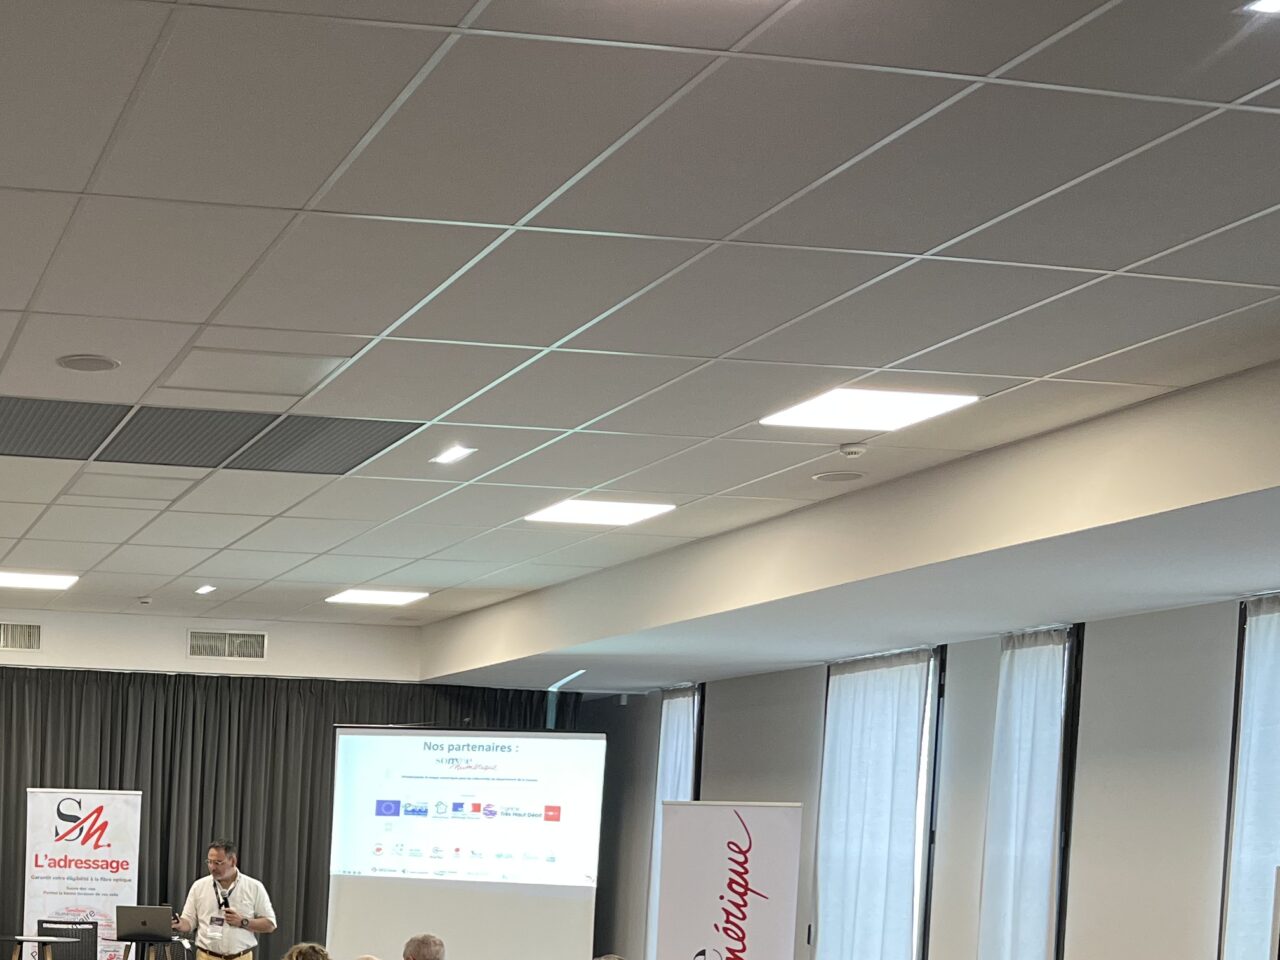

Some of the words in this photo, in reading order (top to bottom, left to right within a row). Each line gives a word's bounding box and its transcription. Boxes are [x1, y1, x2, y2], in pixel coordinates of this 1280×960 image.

[423, 741, 444, 751] Nos
[447, 742, 512, 753] partenaires
[34, 853, 130, 874] L'adressage
